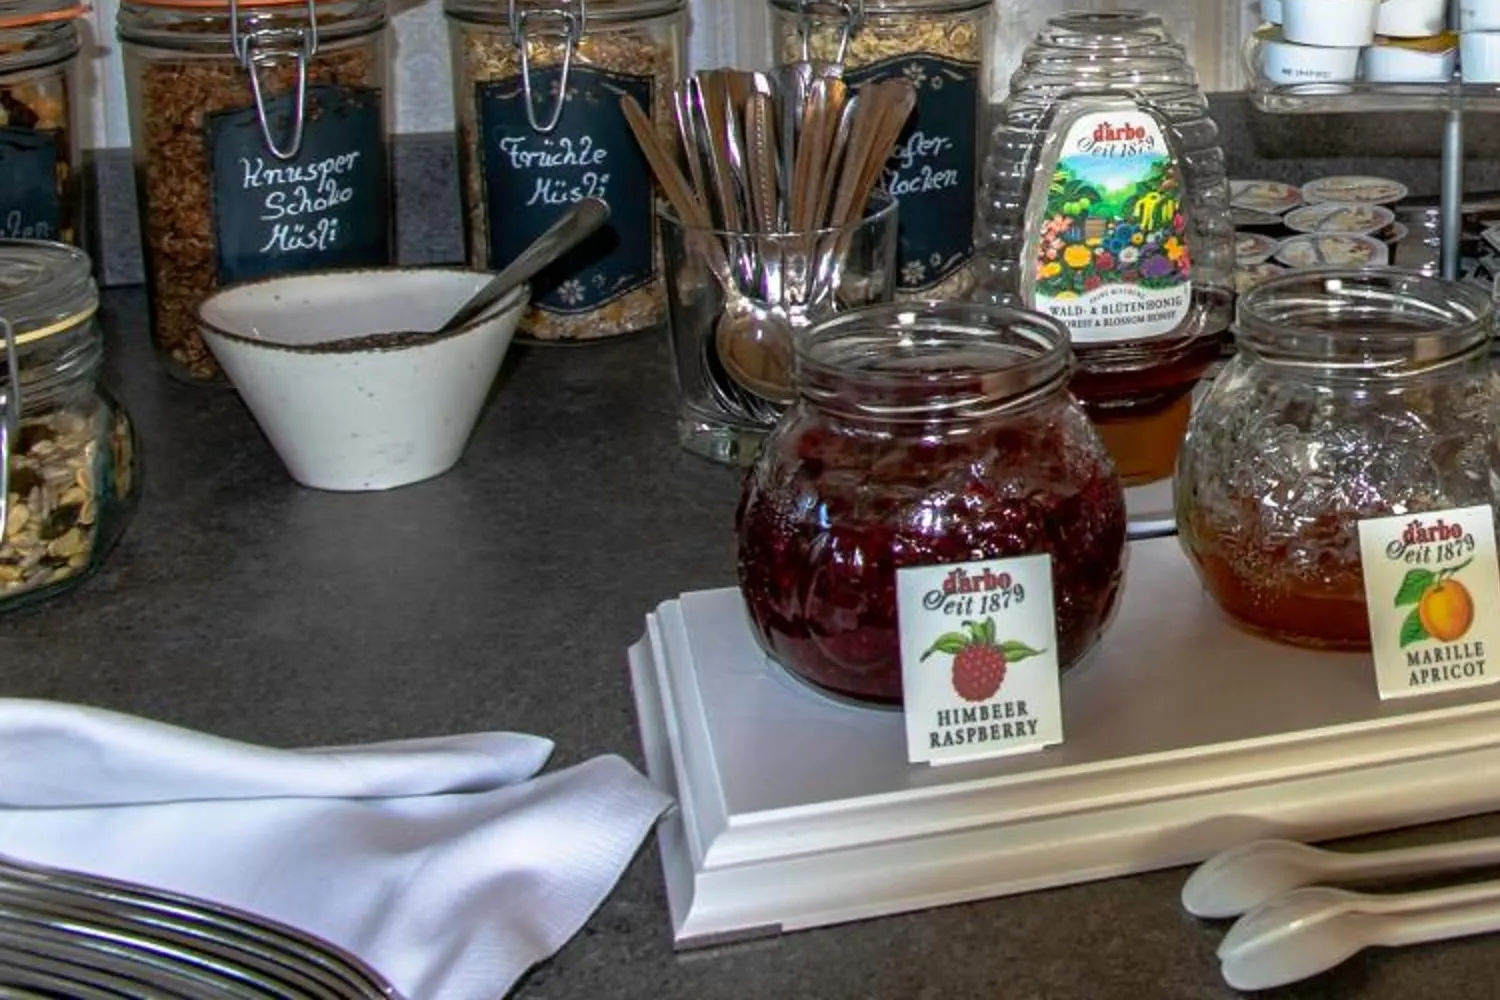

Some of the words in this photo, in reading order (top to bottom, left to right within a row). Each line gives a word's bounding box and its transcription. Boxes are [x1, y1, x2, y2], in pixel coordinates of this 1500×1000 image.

[500, 136, 608, 169] Früchte
[893, 131, 953, 169] afer-
[240, 151, 361, 193] Knusper
[526, 171, 611, 206] Müsli
[260, 178, 353, 221] Schoko
[259, 218, 338, 252] Müsli
[1063, 318, 1093, 329] OREST
[1386, 539, 1432, 564] Seit
[1436, 533, 1475, 563] 1879
[922, 590, 974, 616] Seit
[979, 583, 1025, 616] 1879
[1406, 641, 1485, 667] MARILLE
[1408, 660, 1487, 687] APRICOT
[937, 700, 1029, 727] HIMBEER
[929, 719, 1039, 749] RASPBERRY
